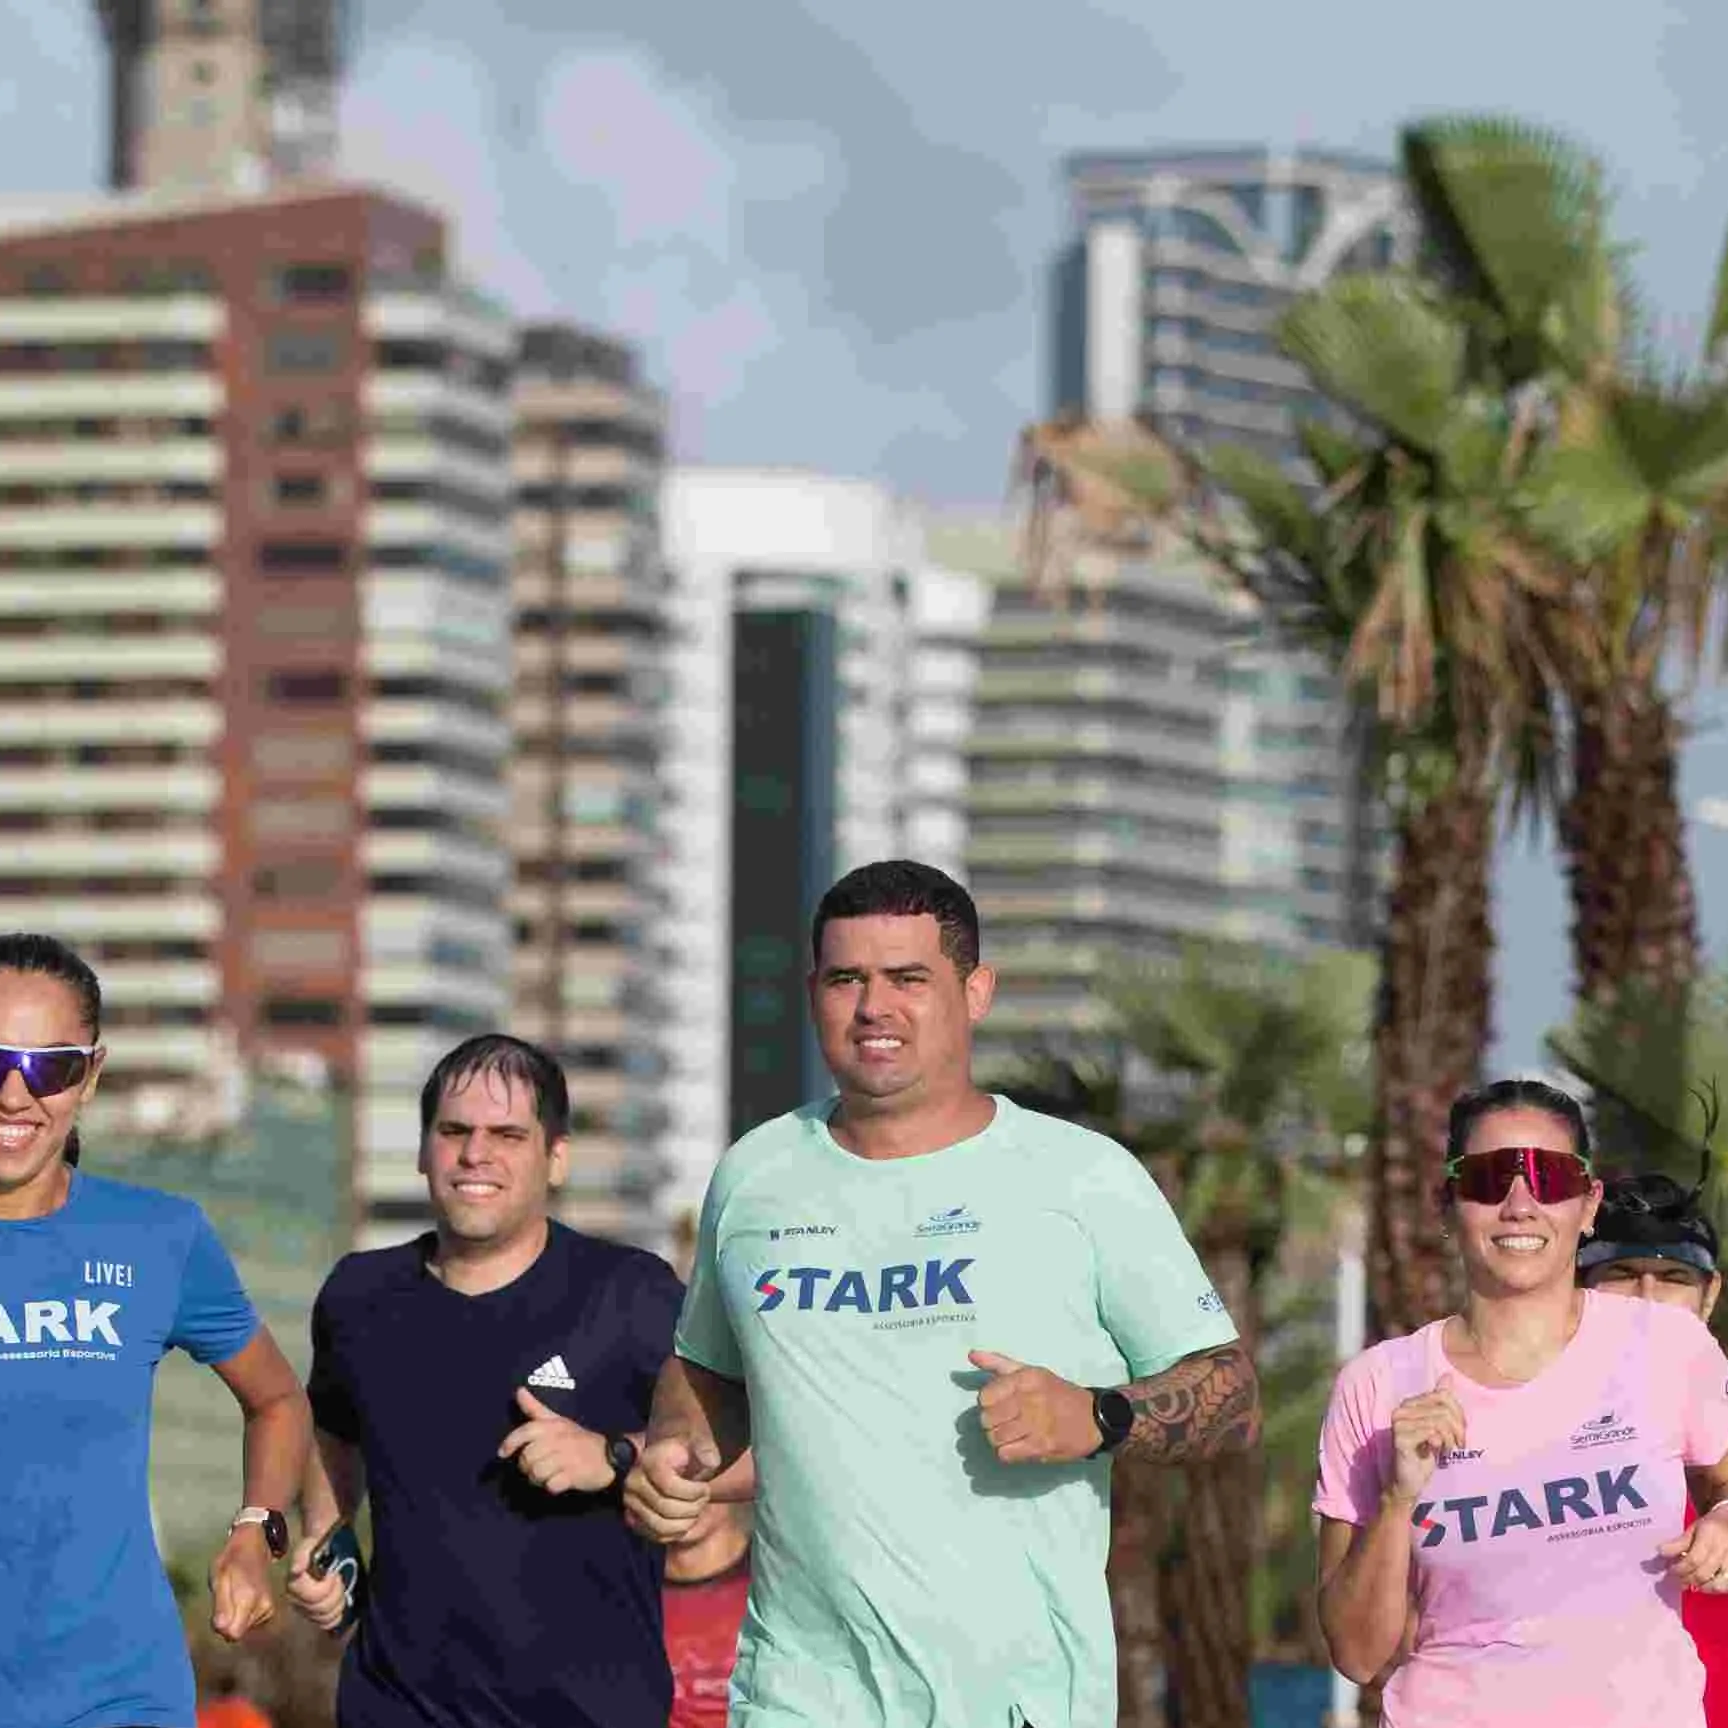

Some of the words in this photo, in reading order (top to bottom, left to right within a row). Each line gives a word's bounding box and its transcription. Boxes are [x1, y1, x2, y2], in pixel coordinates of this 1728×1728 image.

[84, 1261, 133, 1287] LIVE!
[754, 1258, 976, 1313] STARK
[1411, 1464, 1648, 1547] STARK
